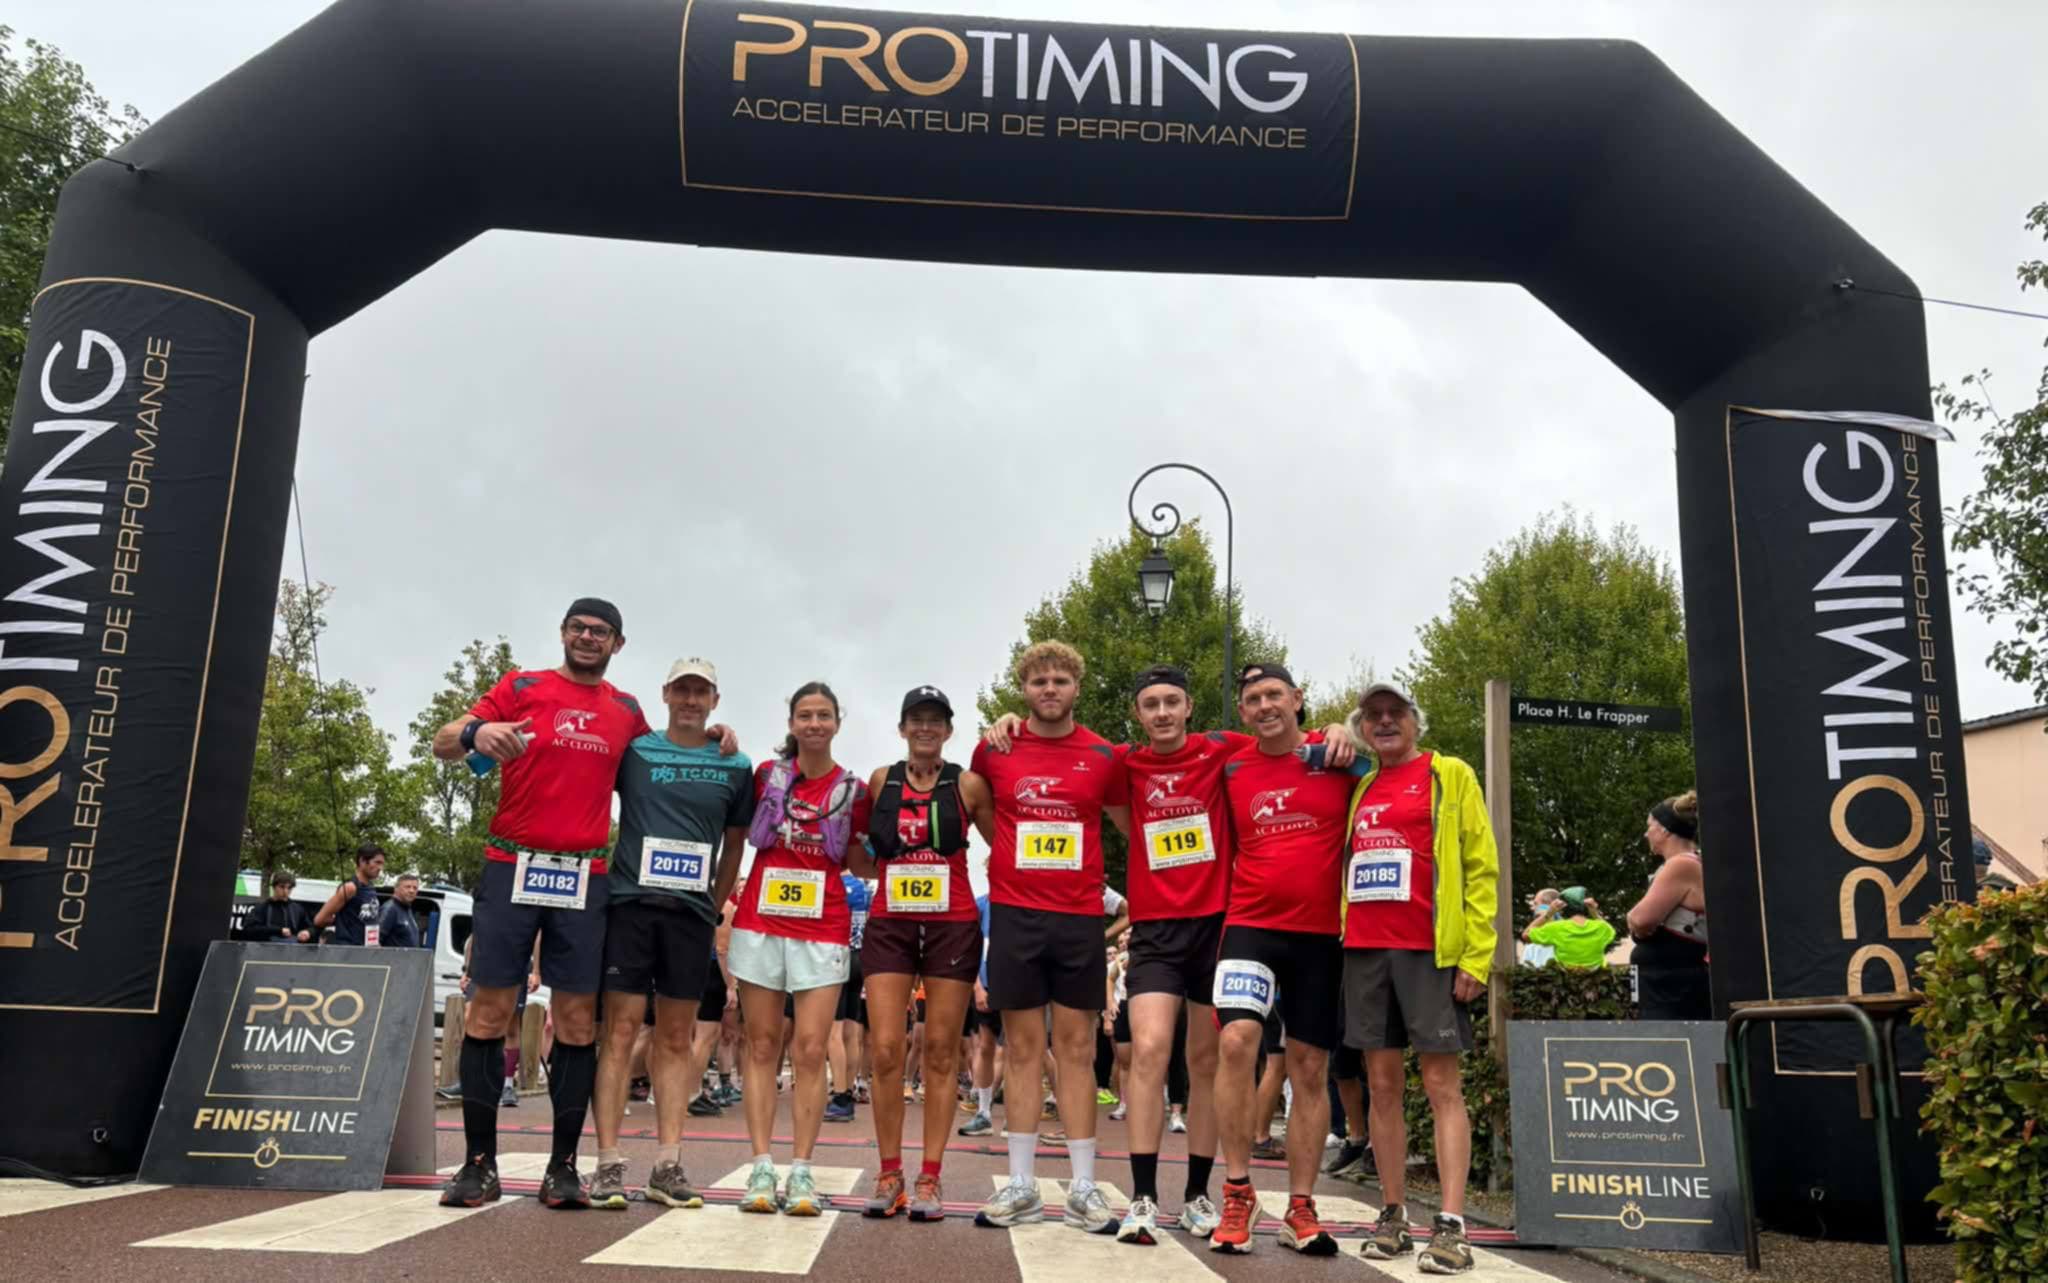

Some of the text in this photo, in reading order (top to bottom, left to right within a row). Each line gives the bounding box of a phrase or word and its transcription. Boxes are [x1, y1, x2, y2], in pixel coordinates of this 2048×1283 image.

[732, 13, 1309, 113] PROTIMING
[732, 97, 1307, 149] ACCELERATEUR DE PERFORMANCE
[1901, 433, 1937, 684] PERFORMANCE
[55, 336, 172, 951] ACCELERATEUR DE PERFORMANCE
[1518, 703, 1650, 726] Place H. Le Frapper
[1924, 694, 1943, 739] DE
[1033, 837, 1067, 854] 147
[1162, 831, 1197, 852] 119
[653, 856, 699, 874] 20175
[1356, 868, 1398, 884] 20185
[527, 872, 576, 892] 20182
[779, 884, 802, 902] 35
[900, 879, 933, 898] 162
[1225, 977, 1268, 998] 20133
[245, 987, 365, 1027] PRO
[243, 1026, 356, 1055] TIMING
[230, 1062, 352, 1075] www.protiming.fr
[1563, 1061, 1677, 1098] PRO
[193, 1108, 359, 1134] FINISHLINE
[1565, 1097, 1680, 1123] TIMING
[1566, 1130, 1686, 1142] www.protiming.fr
[1551, 1173, 1712, 1199] FINISHLINE
